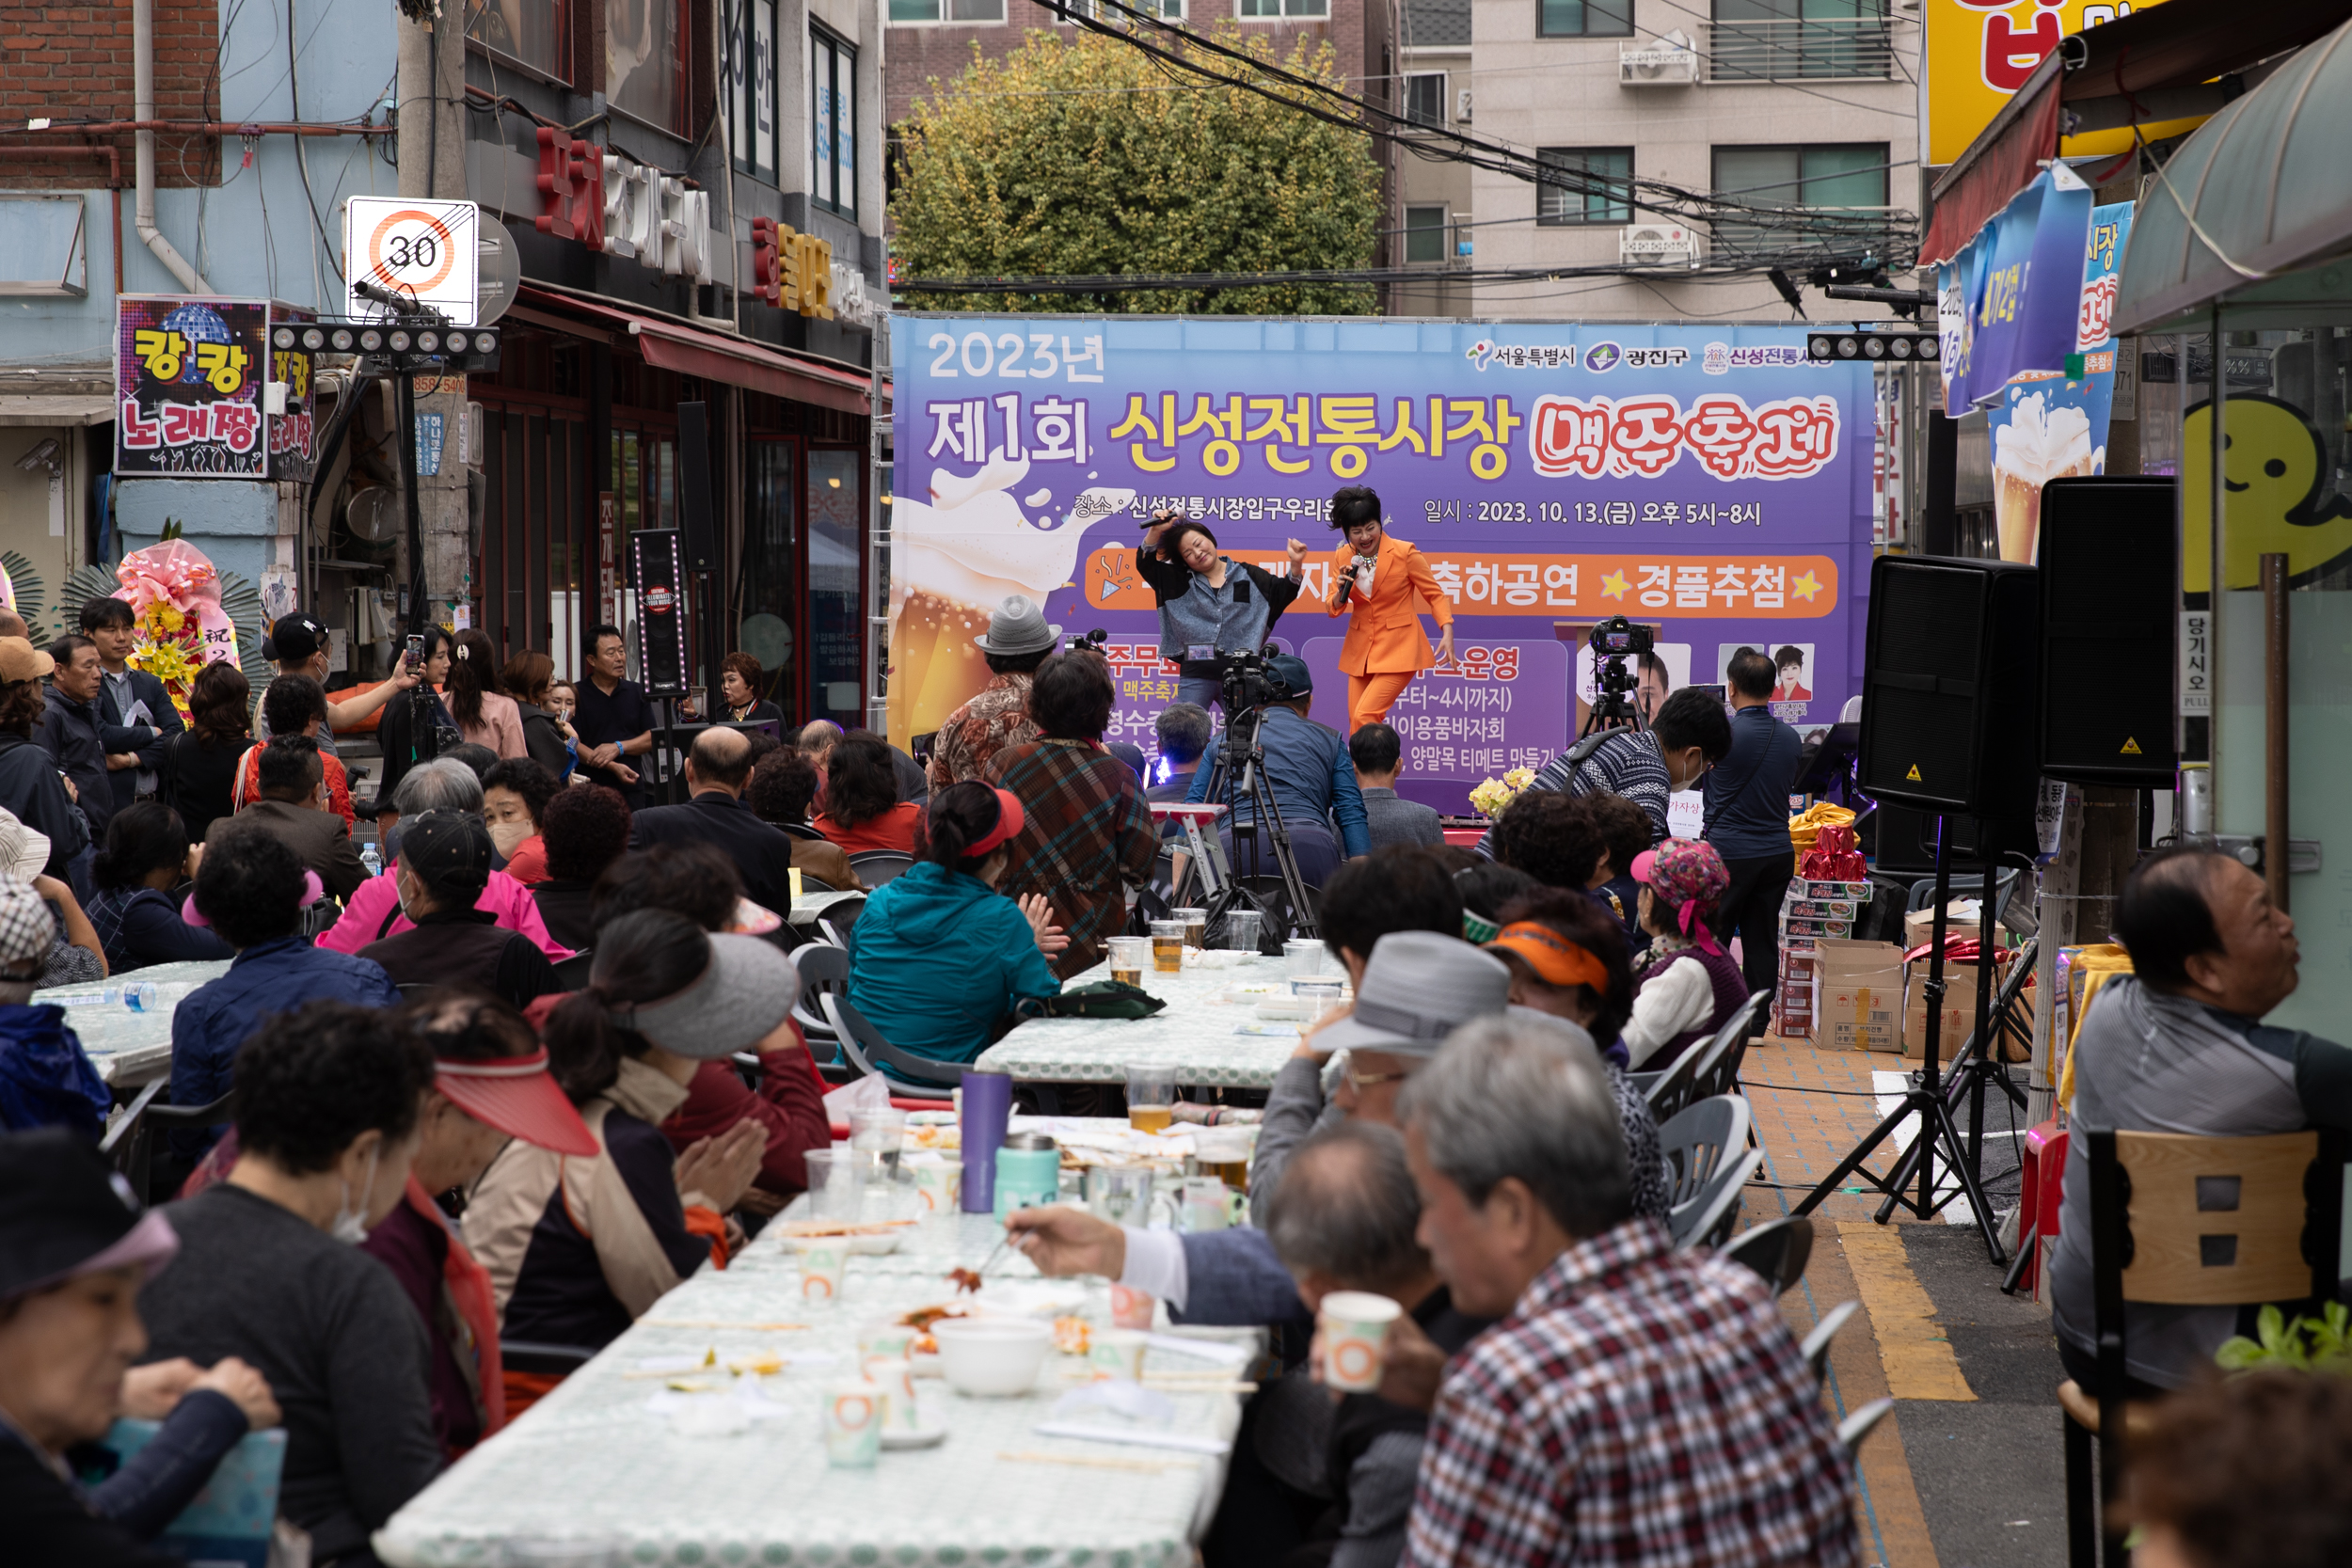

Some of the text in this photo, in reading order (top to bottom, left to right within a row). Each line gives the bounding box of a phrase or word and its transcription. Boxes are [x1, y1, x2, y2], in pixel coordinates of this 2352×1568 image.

[390, 236, 436, 267] 30
[929, 332, 1104, 383] 2023년
[1495, 347, 1575, 365] 서울특별시
[1626, 349, 1689, 366] 광진구
[124, 402, 259, 451] 노래짱
[928, 395, 1836, 481] 제1회 신성전통시장 맥주축제
[1074, 495, 1113, 517] 장소
[1424, 499, 1461, 522] 일시
[1641, 501, 1680, 525] 오후
[1686, 501, 1761, 526] 5시~8시
[1429, 561, 1786, 609] 축하공연 경품추첨
[2187, 617, 2205, 690] 당기시오
[2184, 697, 2209, 707] PULL
[1411, 745, 1457, 771] 양말목
